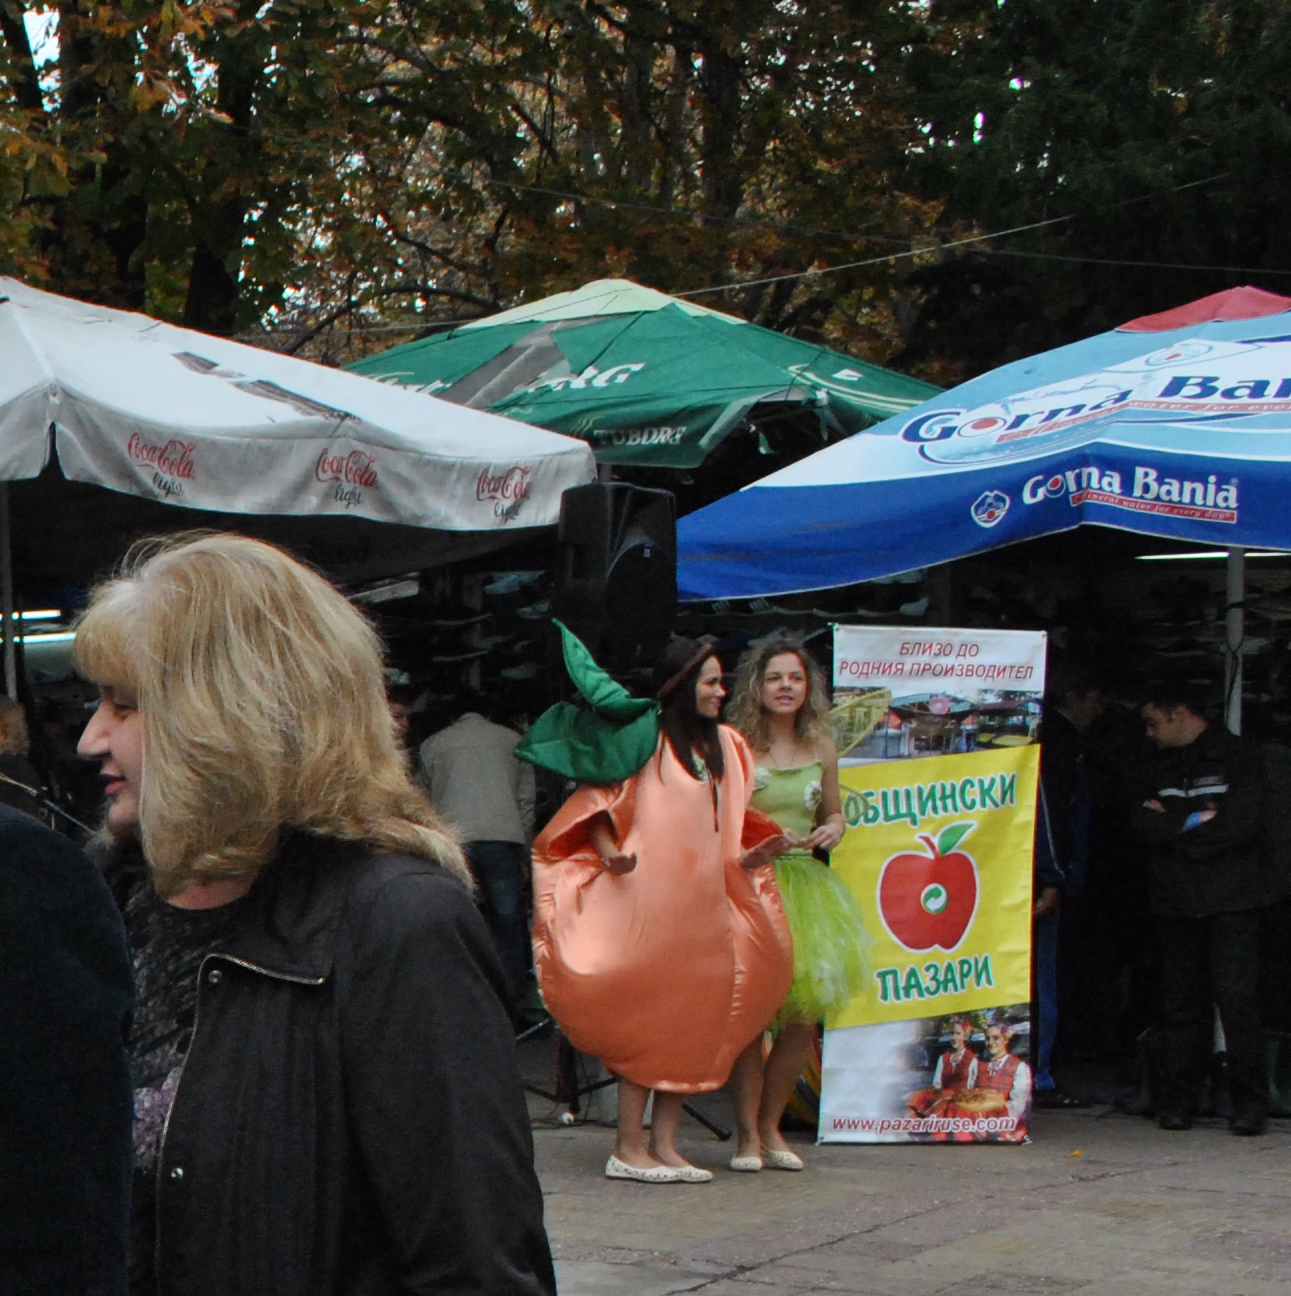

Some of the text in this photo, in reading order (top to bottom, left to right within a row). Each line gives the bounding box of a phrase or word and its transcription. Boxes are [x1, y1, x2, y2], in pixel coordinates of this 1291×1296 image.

[903, 389, 1133, 443] Gorna
[1022, 466, 1239, 508] Gorna Bania
[899, 642, 979, 658] БЛИЗО ДО
[839, 662, 1033, 681] РОДНИЯ ПРОИЗВОДИТЕЛ
[843, 773, 1017, 828] ОБЩИНСКИ
[876, 954, 994, 1003] ПАЗАРИ
[832, 1115, 1017, 1133] www.pazariruse.com
